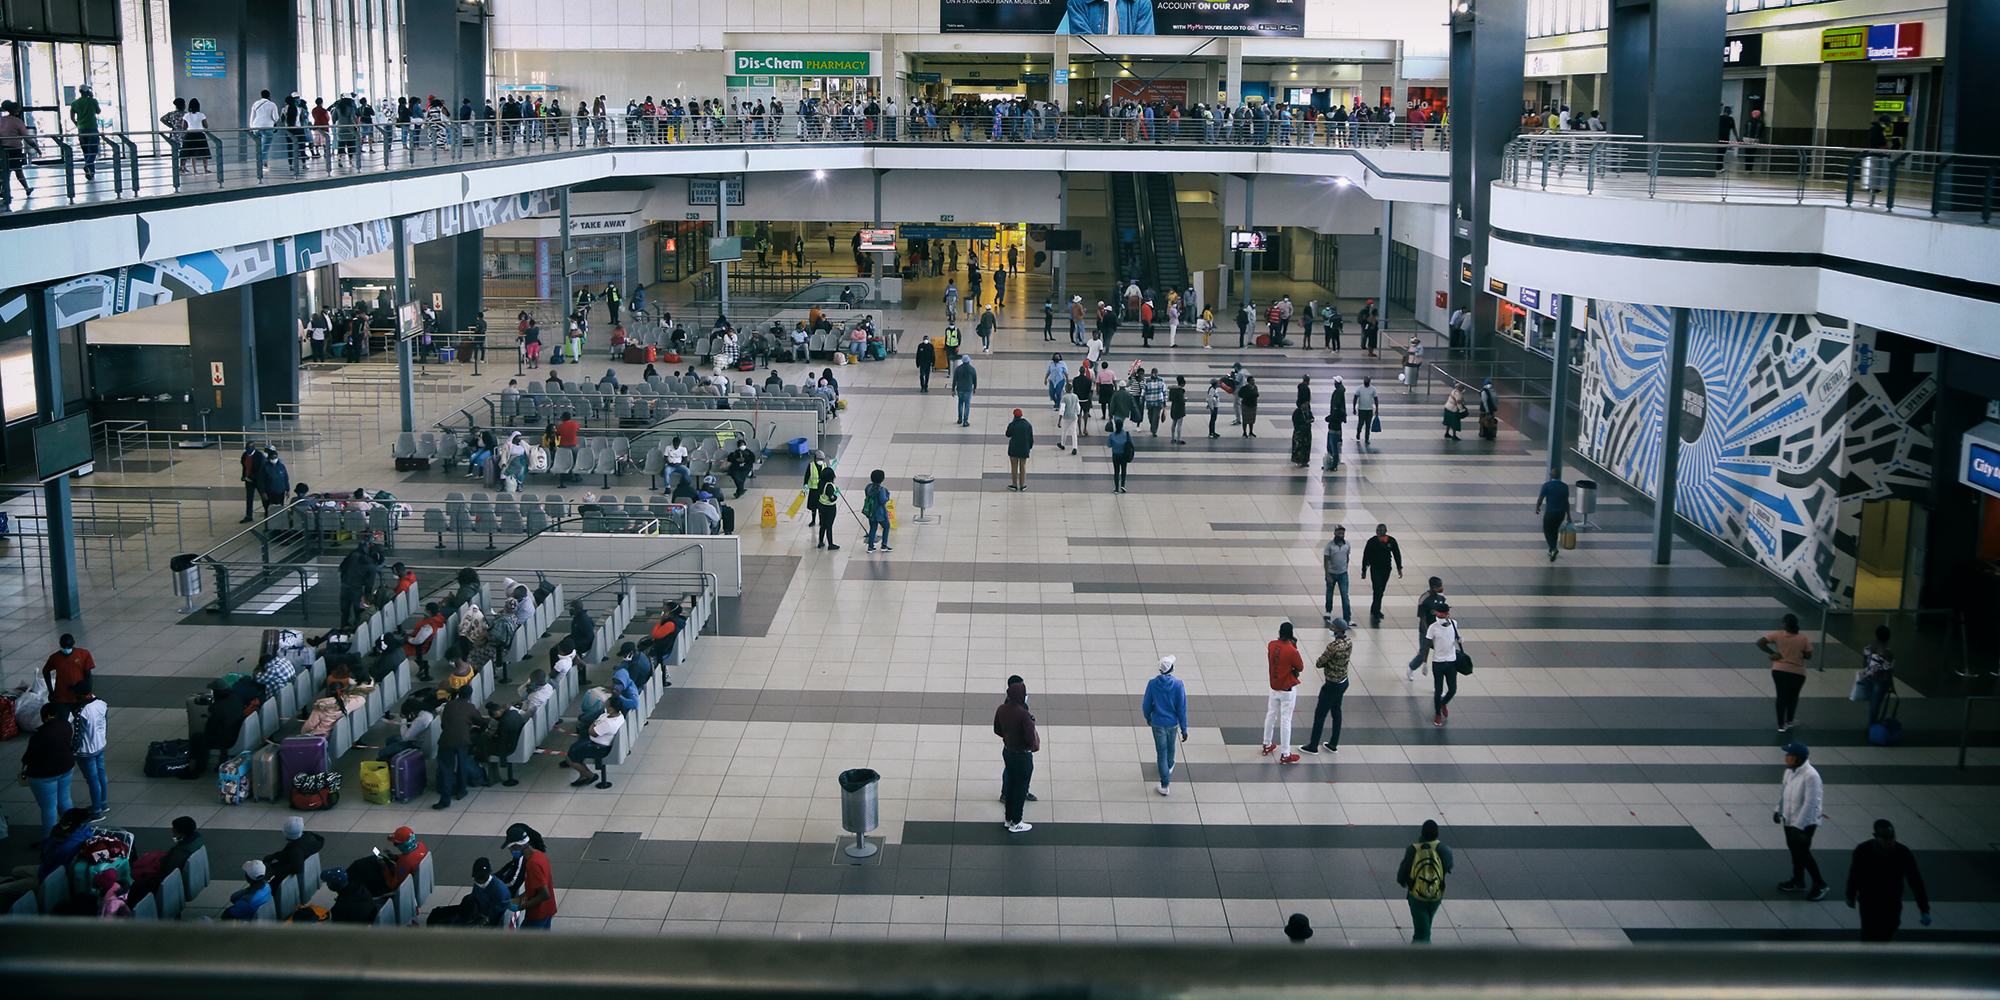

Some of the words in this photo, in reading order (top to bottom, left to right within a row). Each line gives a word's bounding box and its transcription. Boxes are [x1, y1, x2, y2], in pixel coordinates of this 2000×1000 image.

[738, 57, 803, 69] Dis-Chem
[806, 61, 866, 69] PHARMACY
[1406, 99, 1428, 109] ello
[580, 221, 601, 229] TAKE
[1822, 368, 1844, 394] PRETORIA
[1905, 387, 1929, 411] SPRINGS
[1973, 458, 1994, 478] City
